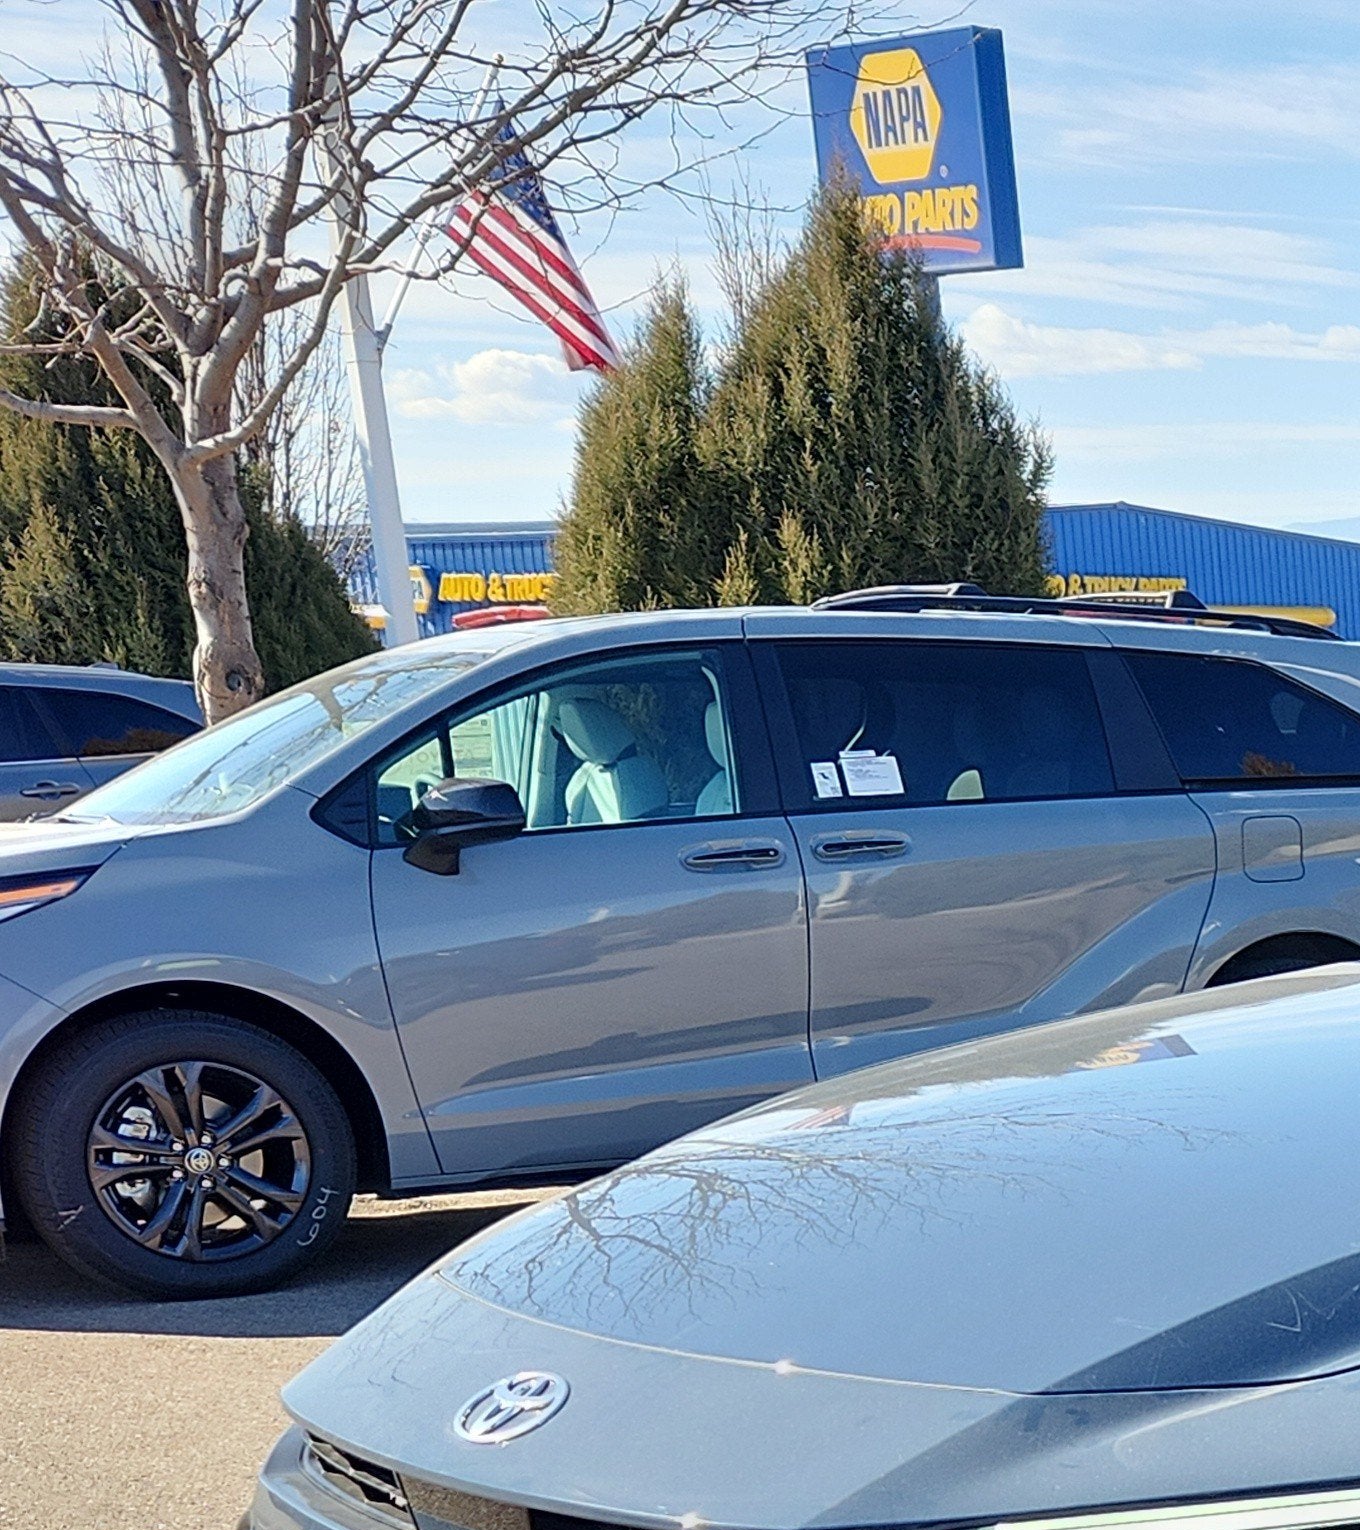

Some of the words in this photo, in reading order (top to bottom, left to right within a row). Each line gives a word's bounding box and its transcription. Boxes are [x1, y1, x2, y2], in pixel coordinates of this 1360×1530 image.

[863, 85, 929, 149] NAPA
[904, 184, 978, 234] PARTS
[438, 573, 485, 601] AUTO
[487, 572, 504, 601] &
